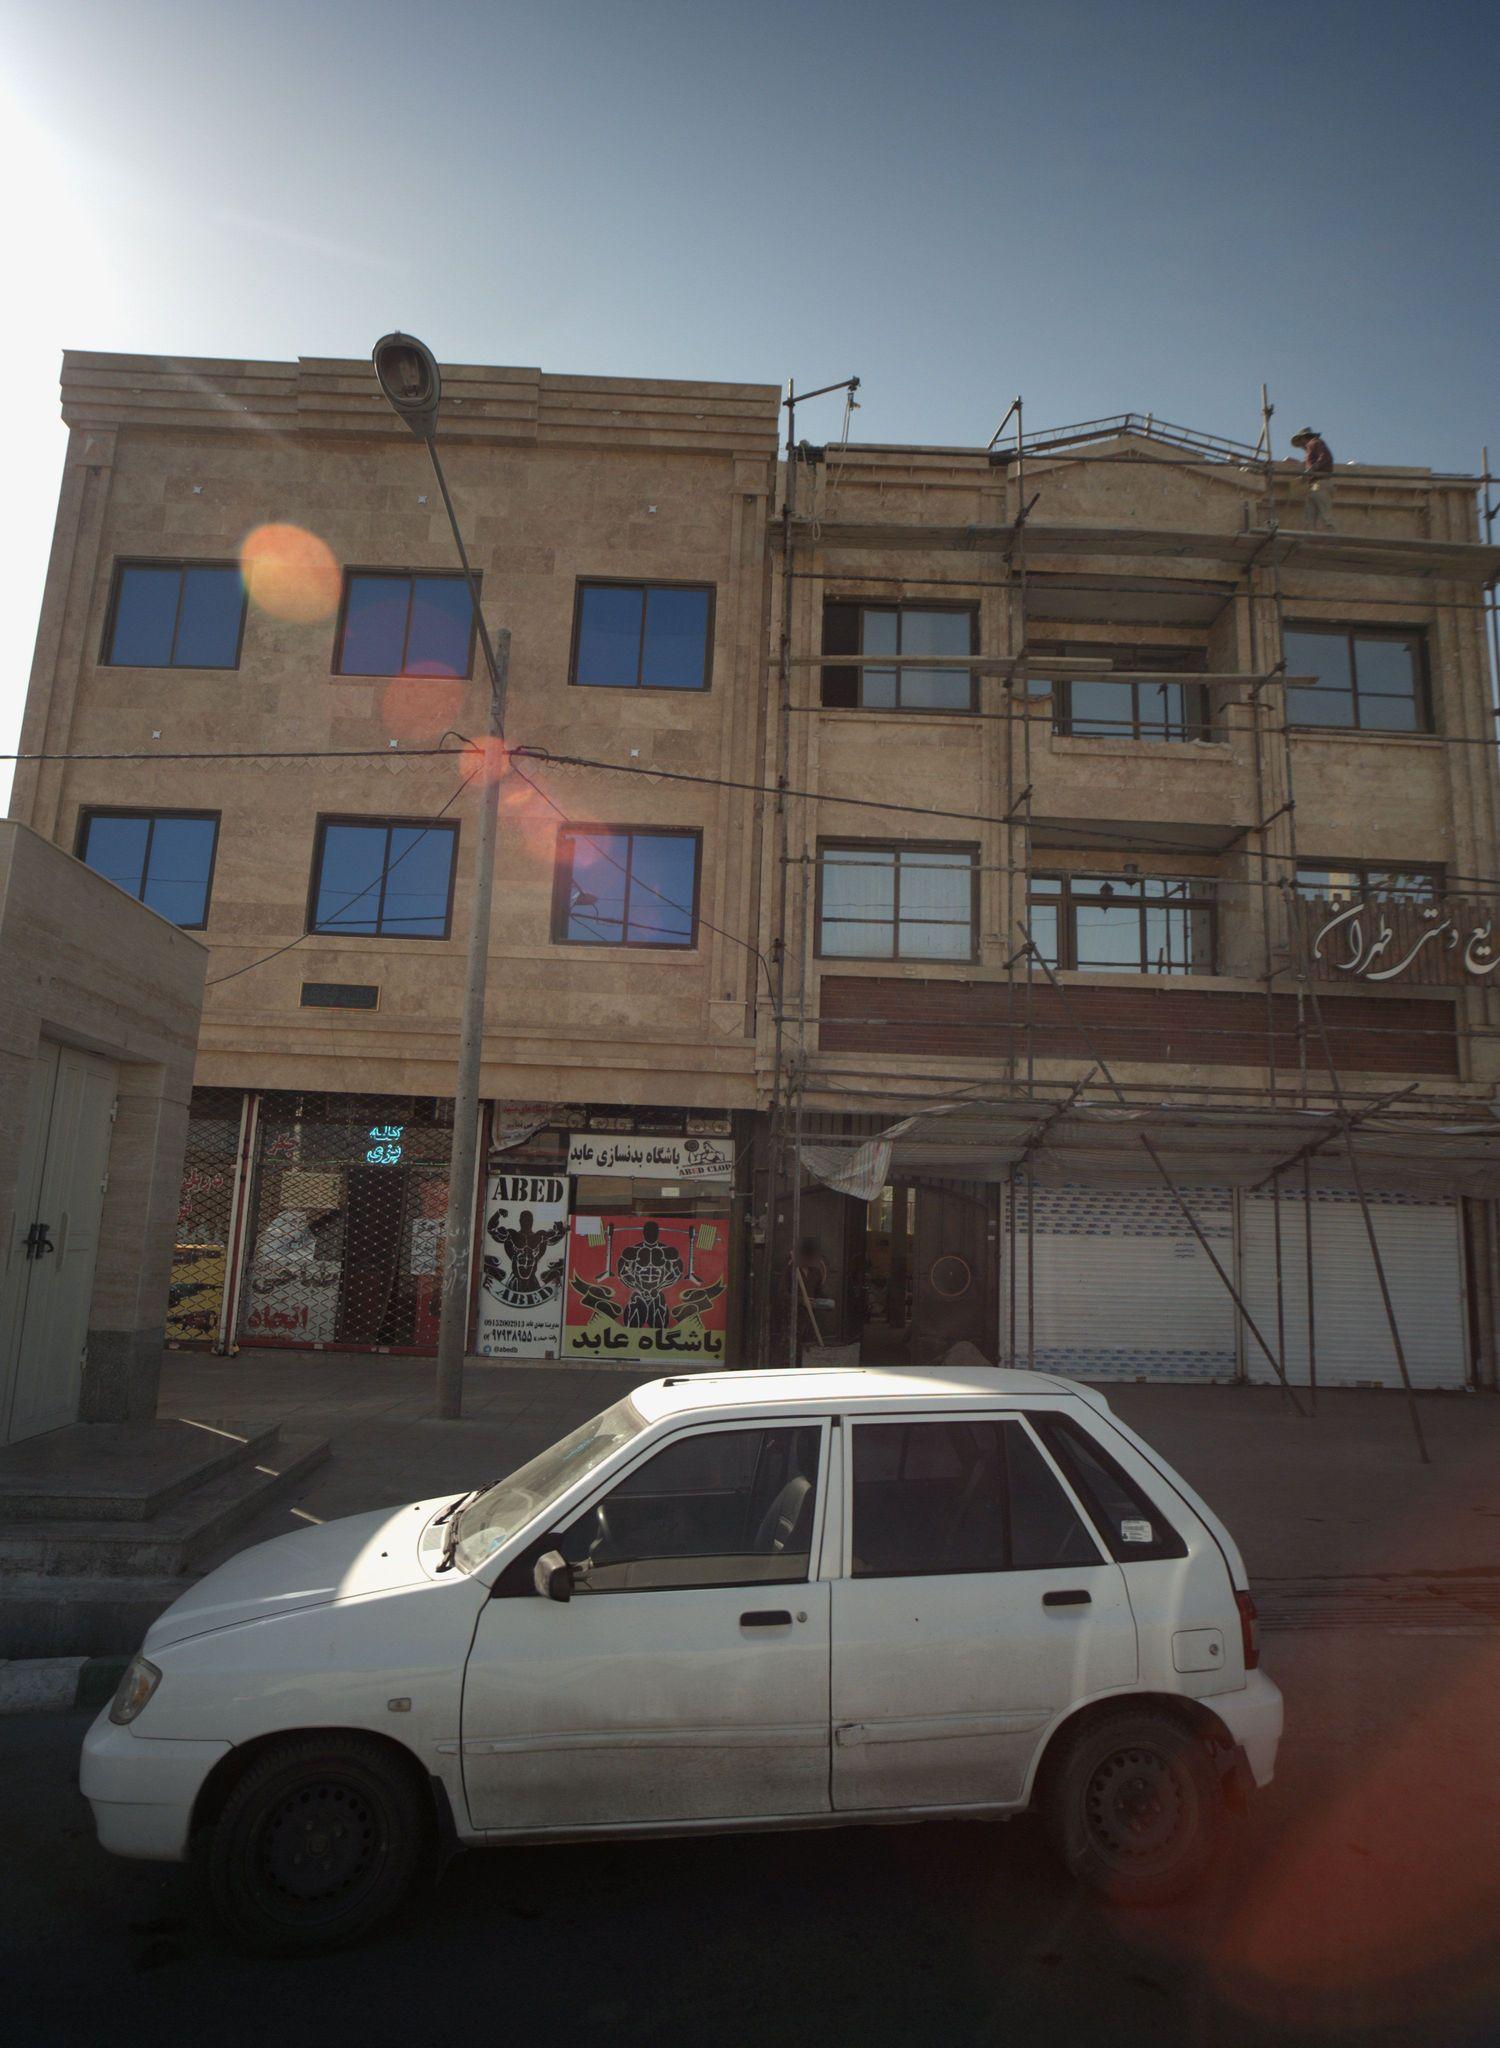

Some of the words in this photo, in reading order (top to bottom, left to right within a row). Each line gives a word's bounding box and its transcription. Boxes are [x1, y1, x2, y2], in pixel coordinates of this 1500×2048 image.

[1315, 902, 1393, 974] طهران
[570, 1144, 594, 1165] عابد
[596, 1145, 643, 1168] بدنسازی
[646, 1146, 680, 1169] باشگاه
[679, 1167, 704, 1176] ABED
[707, 1163, 732, 1173] CLOP
[492, 1176, 564, 1202] ABED
[495, 1286, 554, 1305] ABED
[571, 1327, 629, 1355] عابد
[638, 1327, 722, 1359] باشگاه
